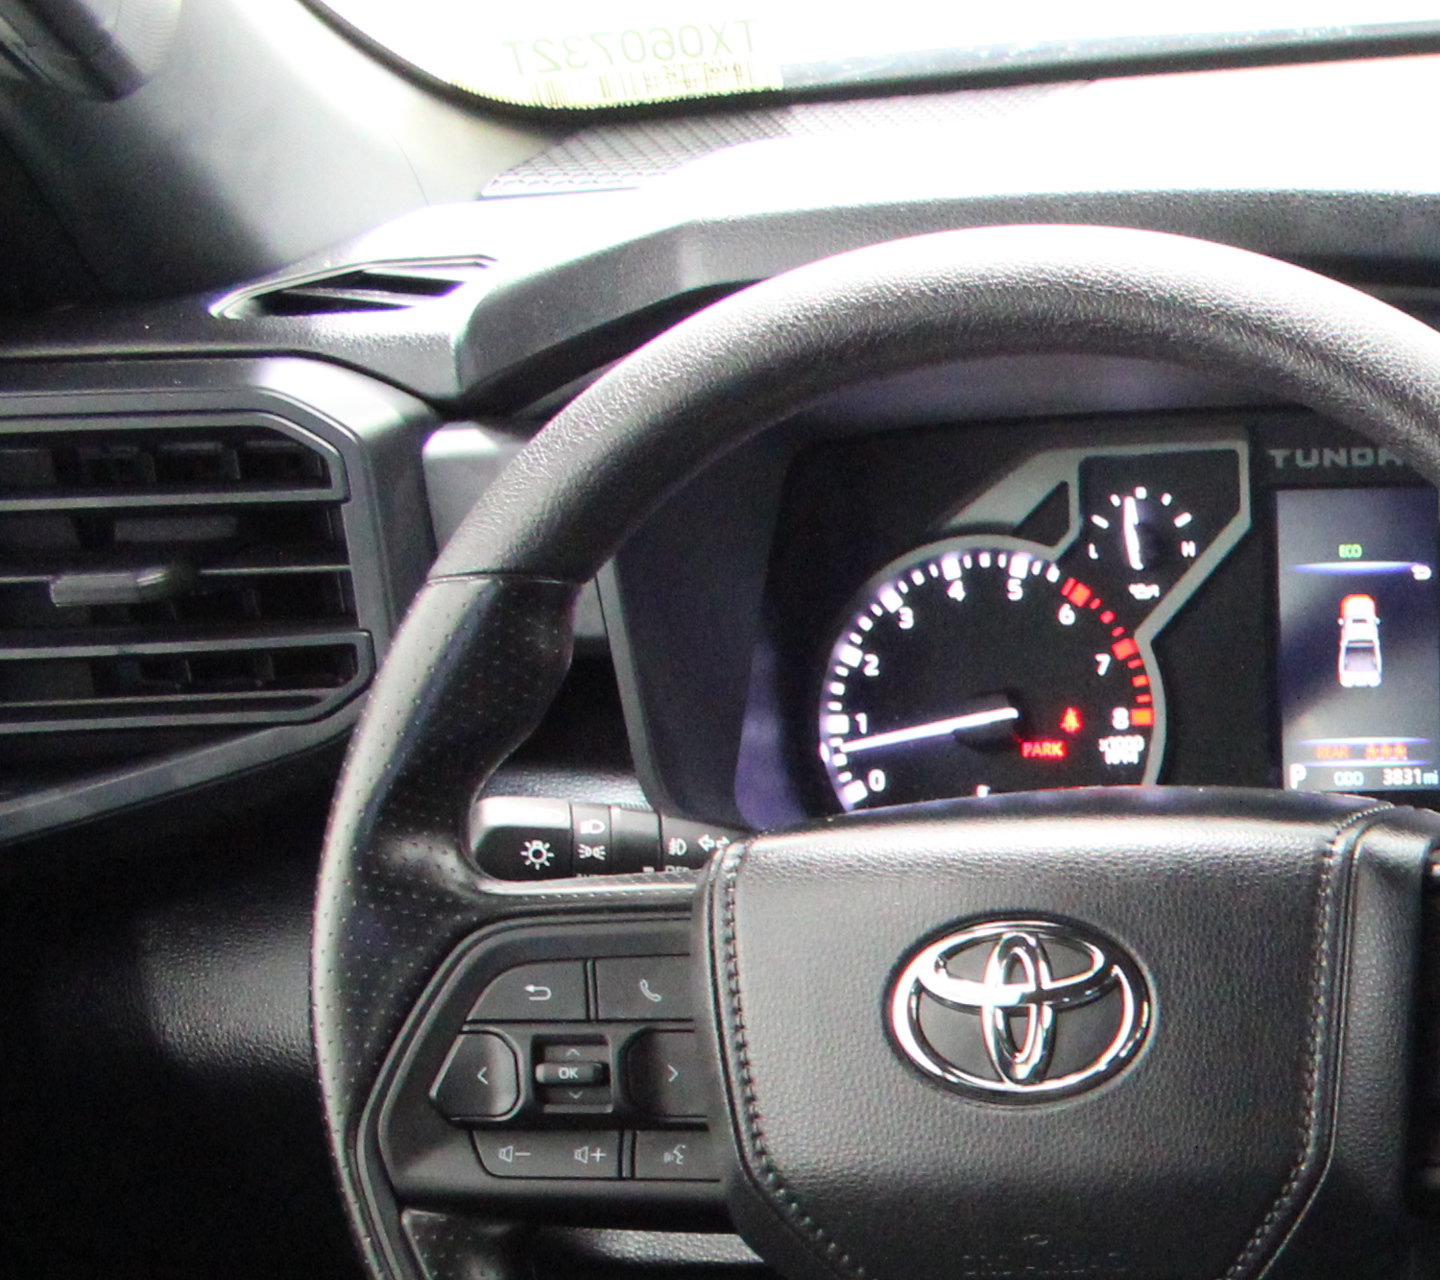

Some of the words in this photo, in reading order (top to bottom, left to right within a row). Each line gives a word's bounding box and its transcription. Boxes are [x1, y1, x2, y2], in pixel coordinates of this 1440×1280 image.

[1268, 447, 1404, 469] TUNDR
[1181, 540, 1196, 558] H
[947, 580, 966, 601] 4
[1006, 578, 1024, 601] 5
[898, 606, 914, 629] 3
[1058, 603, 1076, 625] 6
[862, 654, 880, 677] 2
[1094, 653, 1111, 676] 7
[855, 712, 868, 735] 1
[1112, 707, 1129, 730] 8
[1022, 740, 1066, 758] PARK
[868, 768, 886, 792] 0
[1289, 763, 1307, 790] P
[558, 1067, 579, 1080] OK
